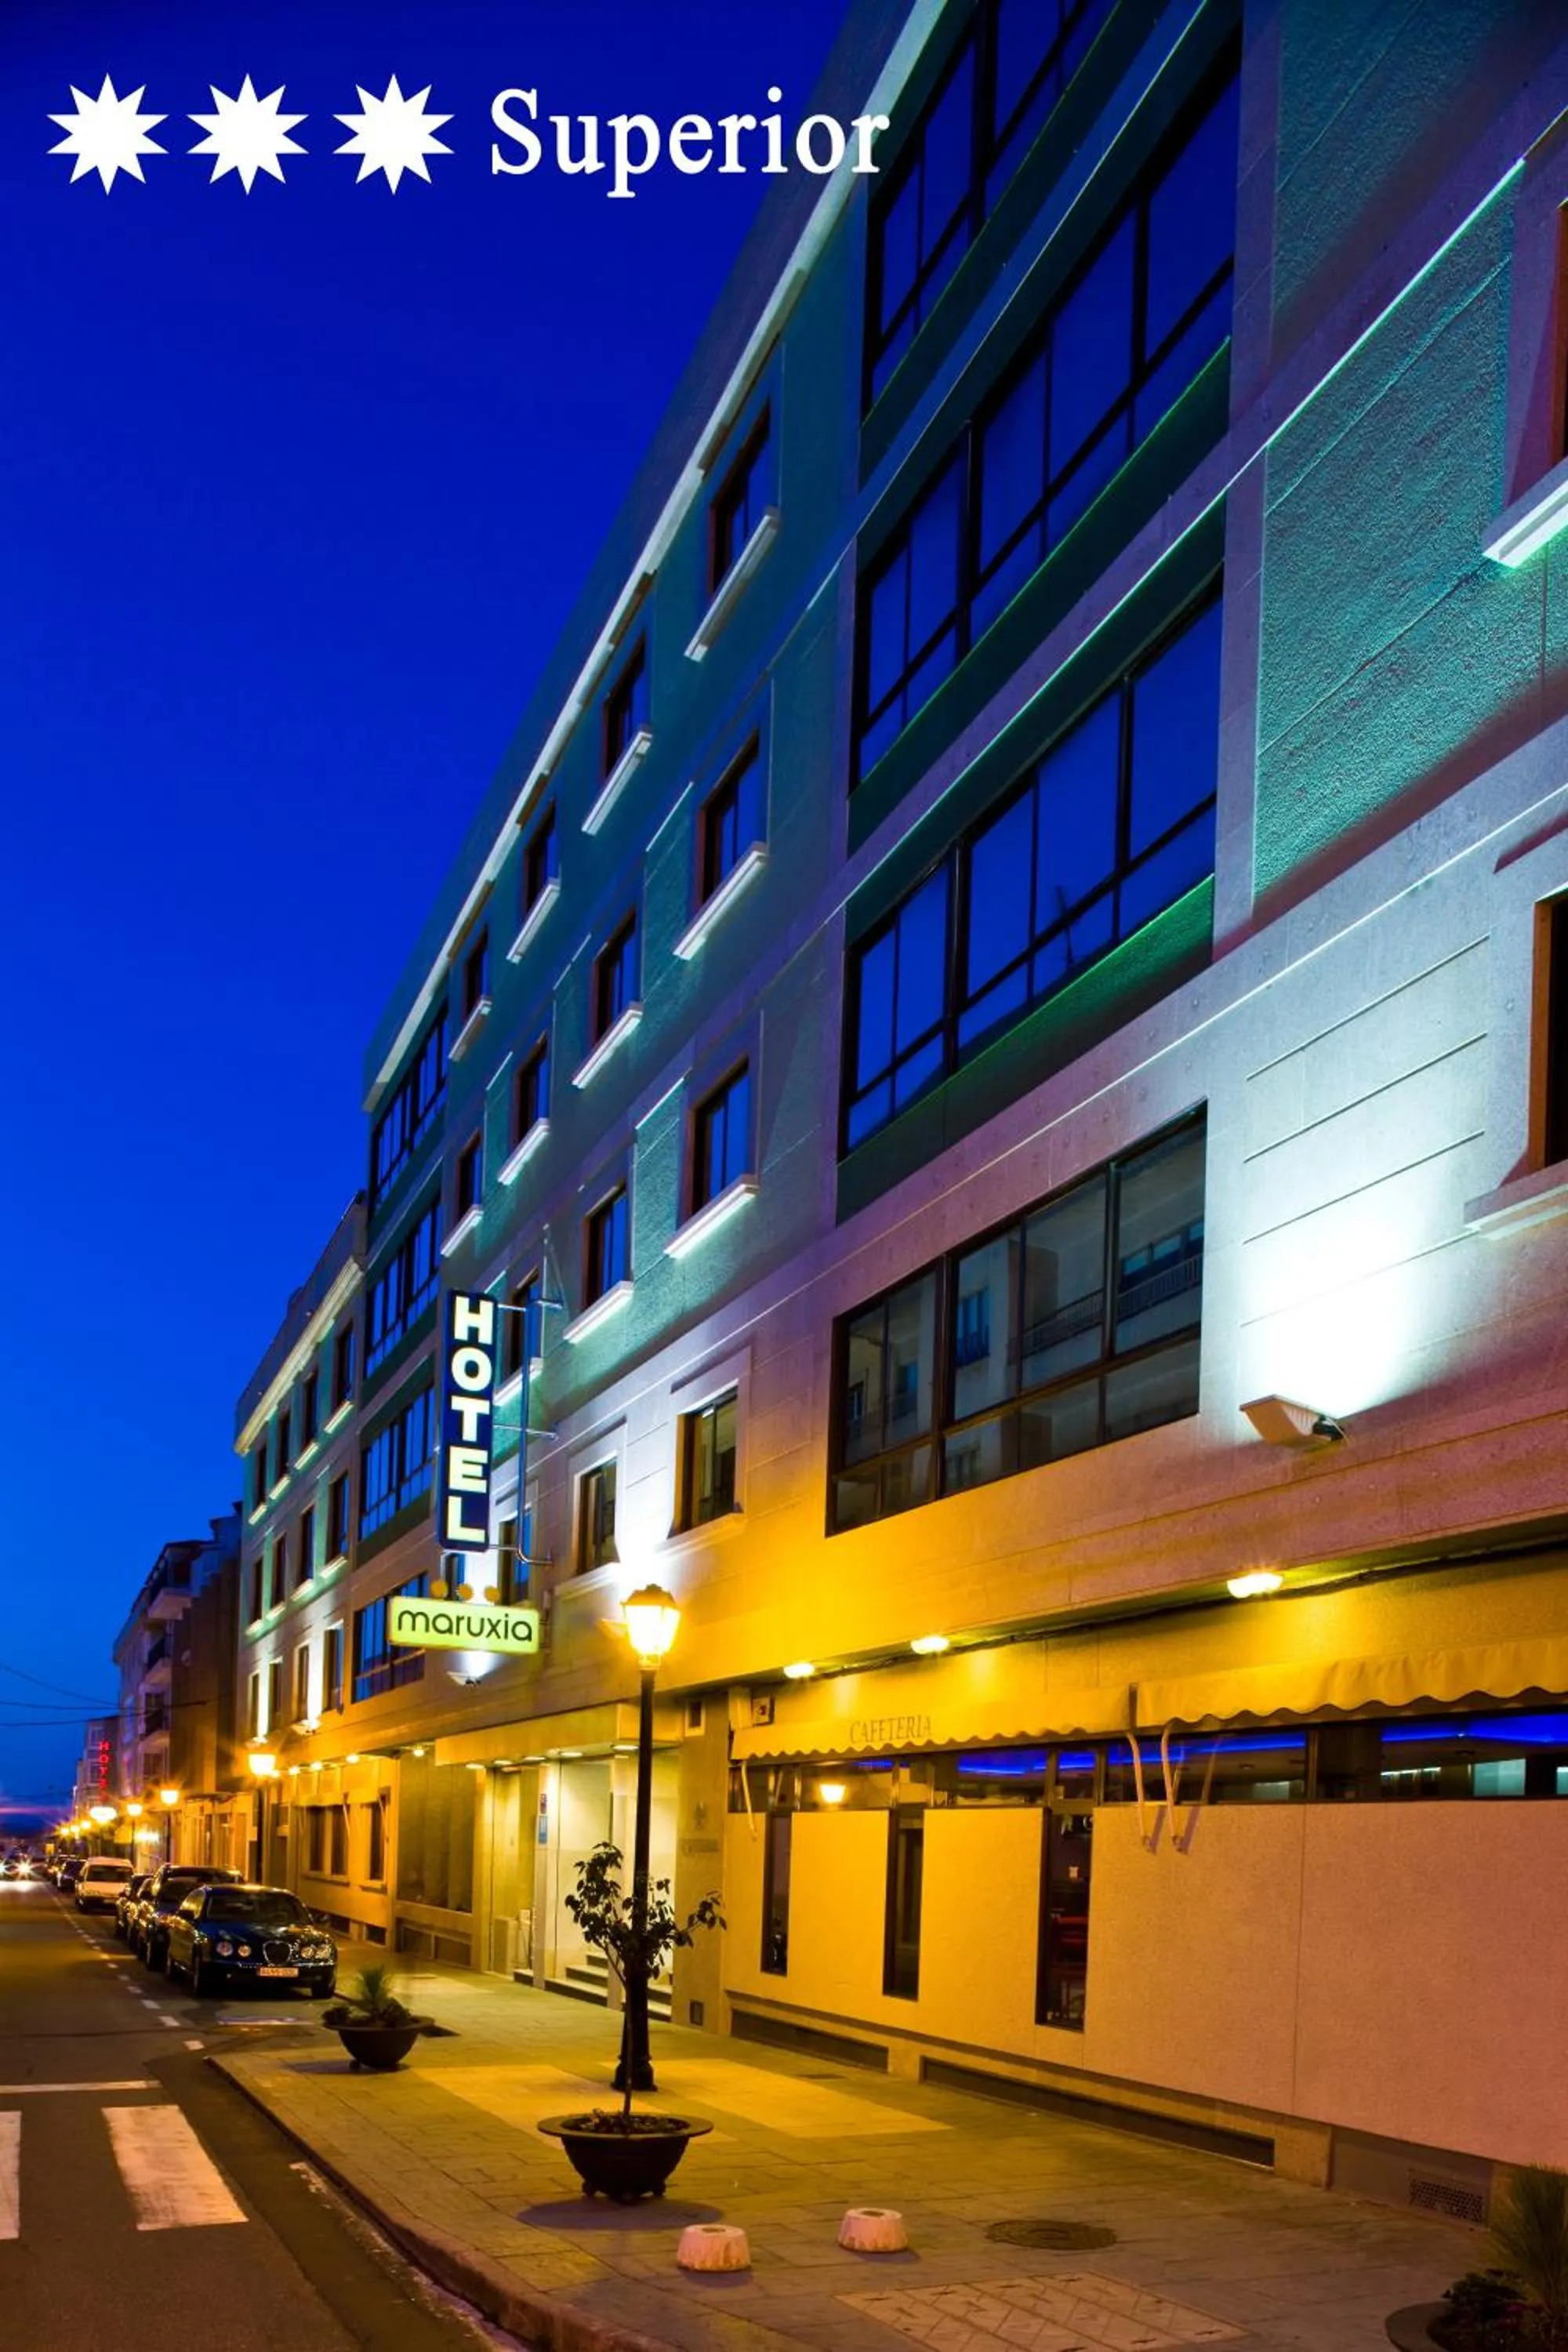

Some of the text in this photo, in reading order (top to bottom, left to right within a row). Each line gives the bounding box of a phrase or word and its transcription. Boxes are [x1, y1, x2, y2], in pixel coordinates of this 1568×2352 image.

[445, 1295, 495, 1543] HOTEL
[397, 1610, 532, 1642] maruxia
[849, 1715, 931, 1744] CAFETERIA
